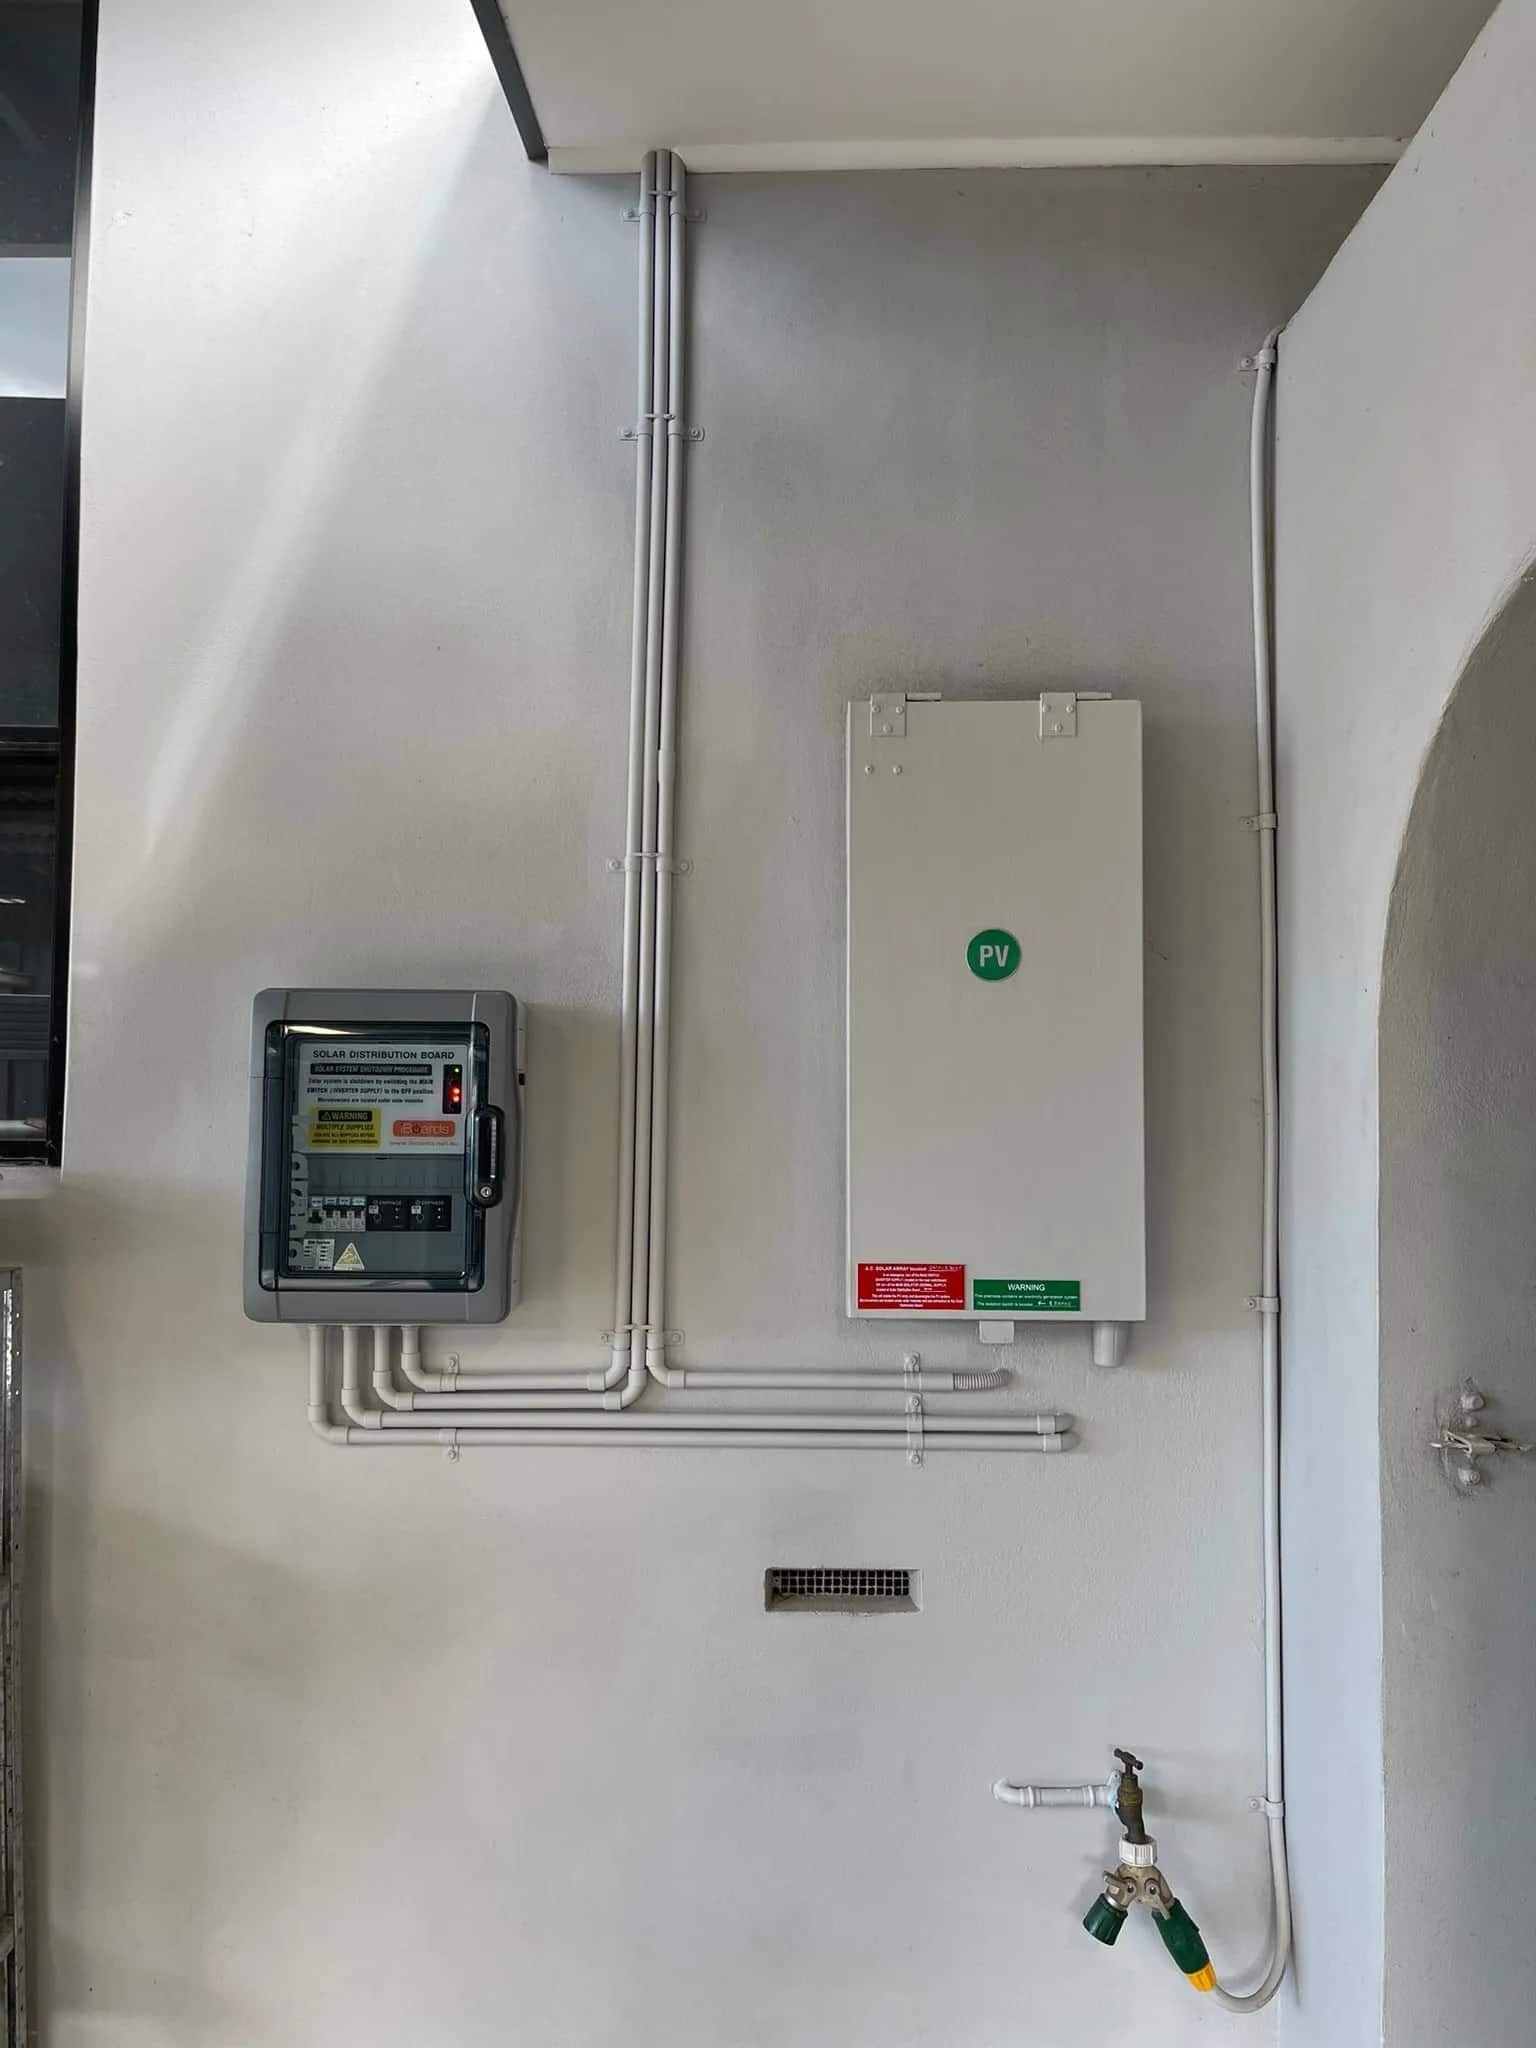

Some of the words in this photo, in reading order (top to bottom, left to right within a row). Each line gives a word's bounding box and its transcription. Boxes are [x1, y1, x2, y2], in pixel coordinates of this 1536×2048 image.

[979, 944, 1009, 968] PV
[313, 1050, 346, 1059] SOLAR
[349, 1050, 417, 1059] DISTRIBUTION
[420, 1051, 455, 1060] BOARD
[314, 1065, 334, 1073] SOLAR
[335, 1065, 358, 1073] SYSTEM
[359, 1065, 393, 1073] SHUTDOWN
[331, 1112, 368, 1120] WARNING
[400, 1122, 449, 1136] iBoards
[1007, 1283, 1046, 1291] WARNING
